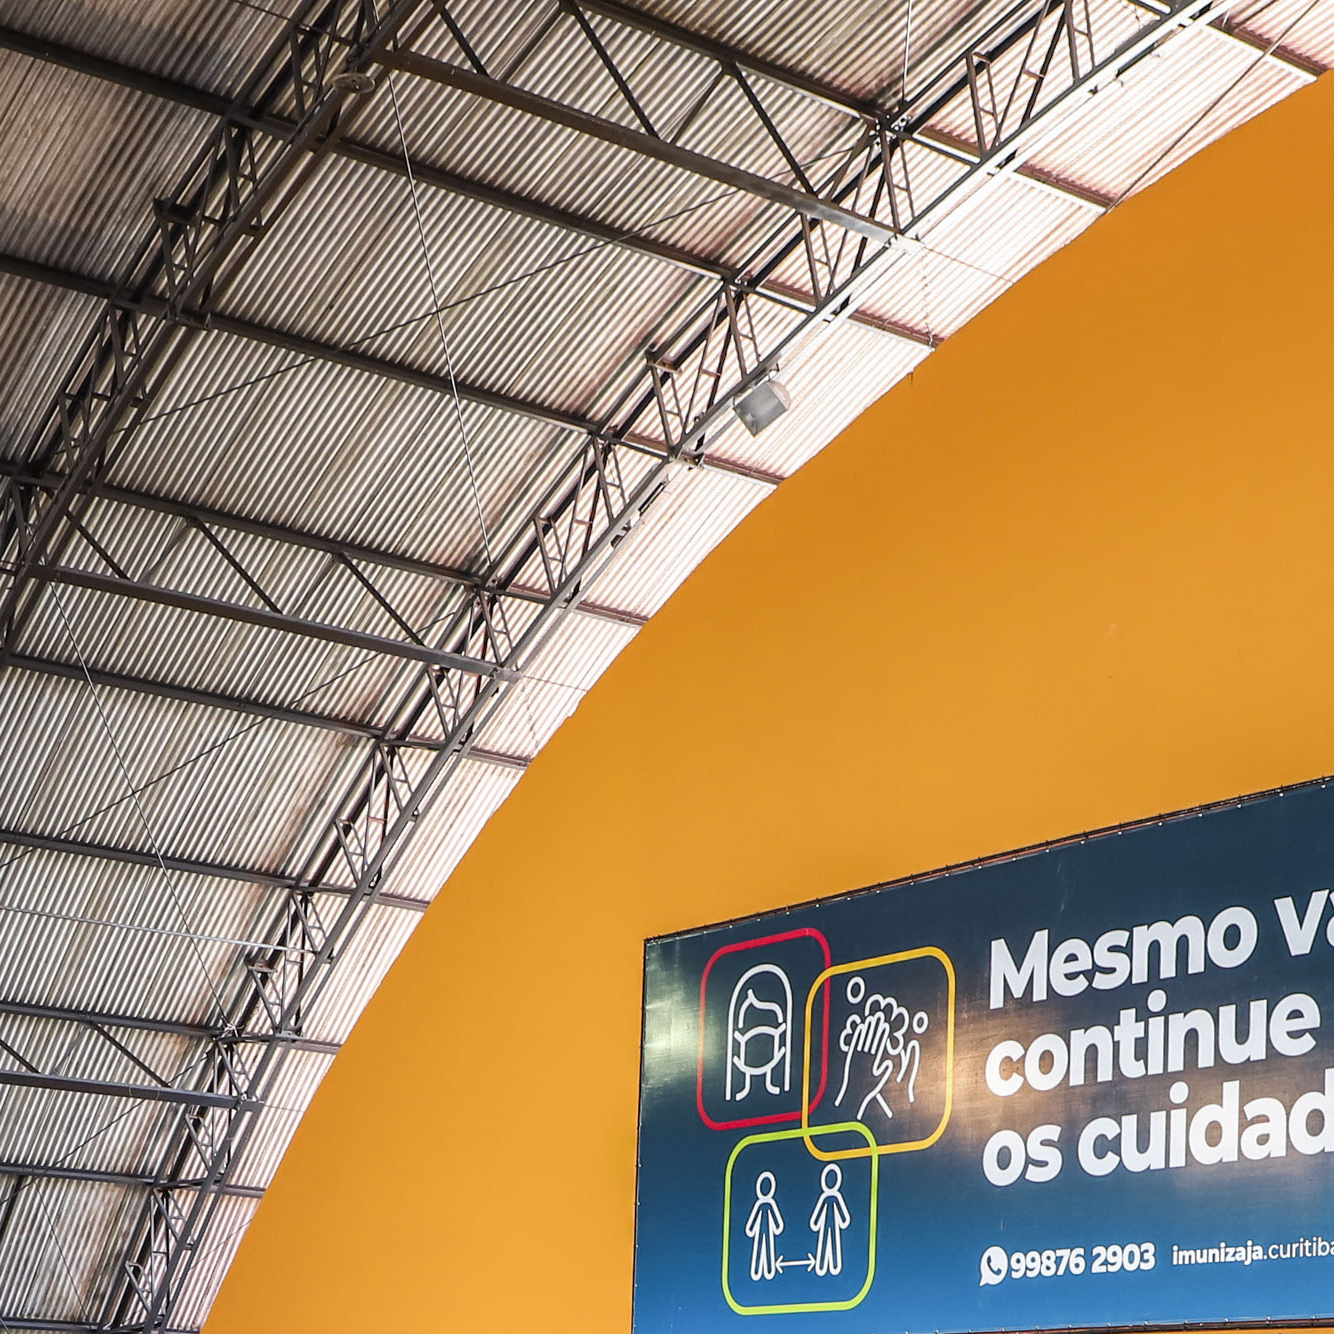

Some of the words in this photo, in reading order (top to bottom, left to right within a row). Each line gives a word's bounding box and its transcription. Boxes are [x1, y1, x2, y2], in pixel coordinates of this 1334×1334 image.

[990, 907, 1257, 1010] Mesmo
[984, 990, 1321, 1096] continue
[983, 1124, 1063, 1187] os
[1009, 1247, 1086, 1279] 99876
[1091, 1242, 1156, 1274] 2903
